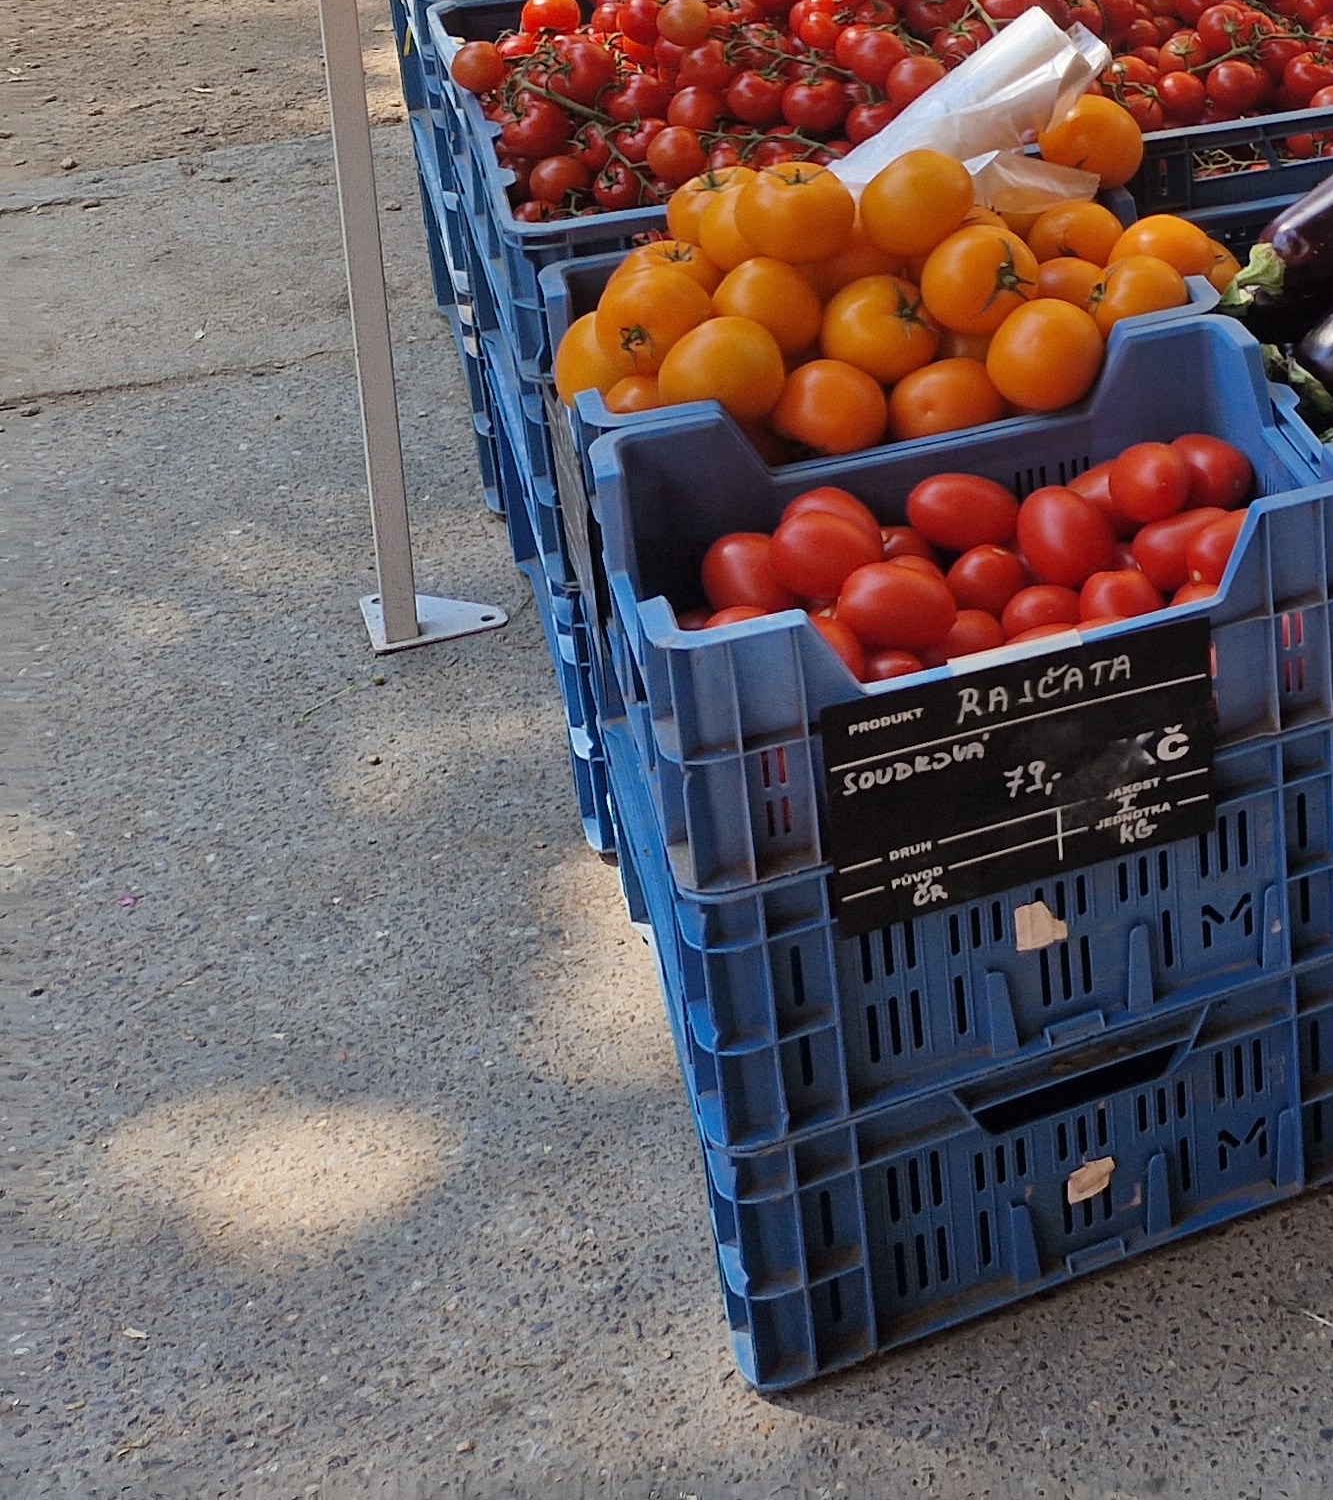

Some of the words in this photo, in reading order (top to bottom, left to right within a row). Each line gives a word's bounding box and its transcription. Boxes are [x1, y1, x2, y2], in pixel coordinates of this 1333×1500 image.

[848, 707, 924, 736] PRODUKT
[956, 654, 1132, 725] RAJČATA
[1094, 800, 1172, 831] JEDNOTKA
[1119, 821, 1157, 844] KG
[889, 840, 933, 862] DRUH
[891, 865, 943, 890] PŮVOD
[913, 879, 948, 907] ČR
